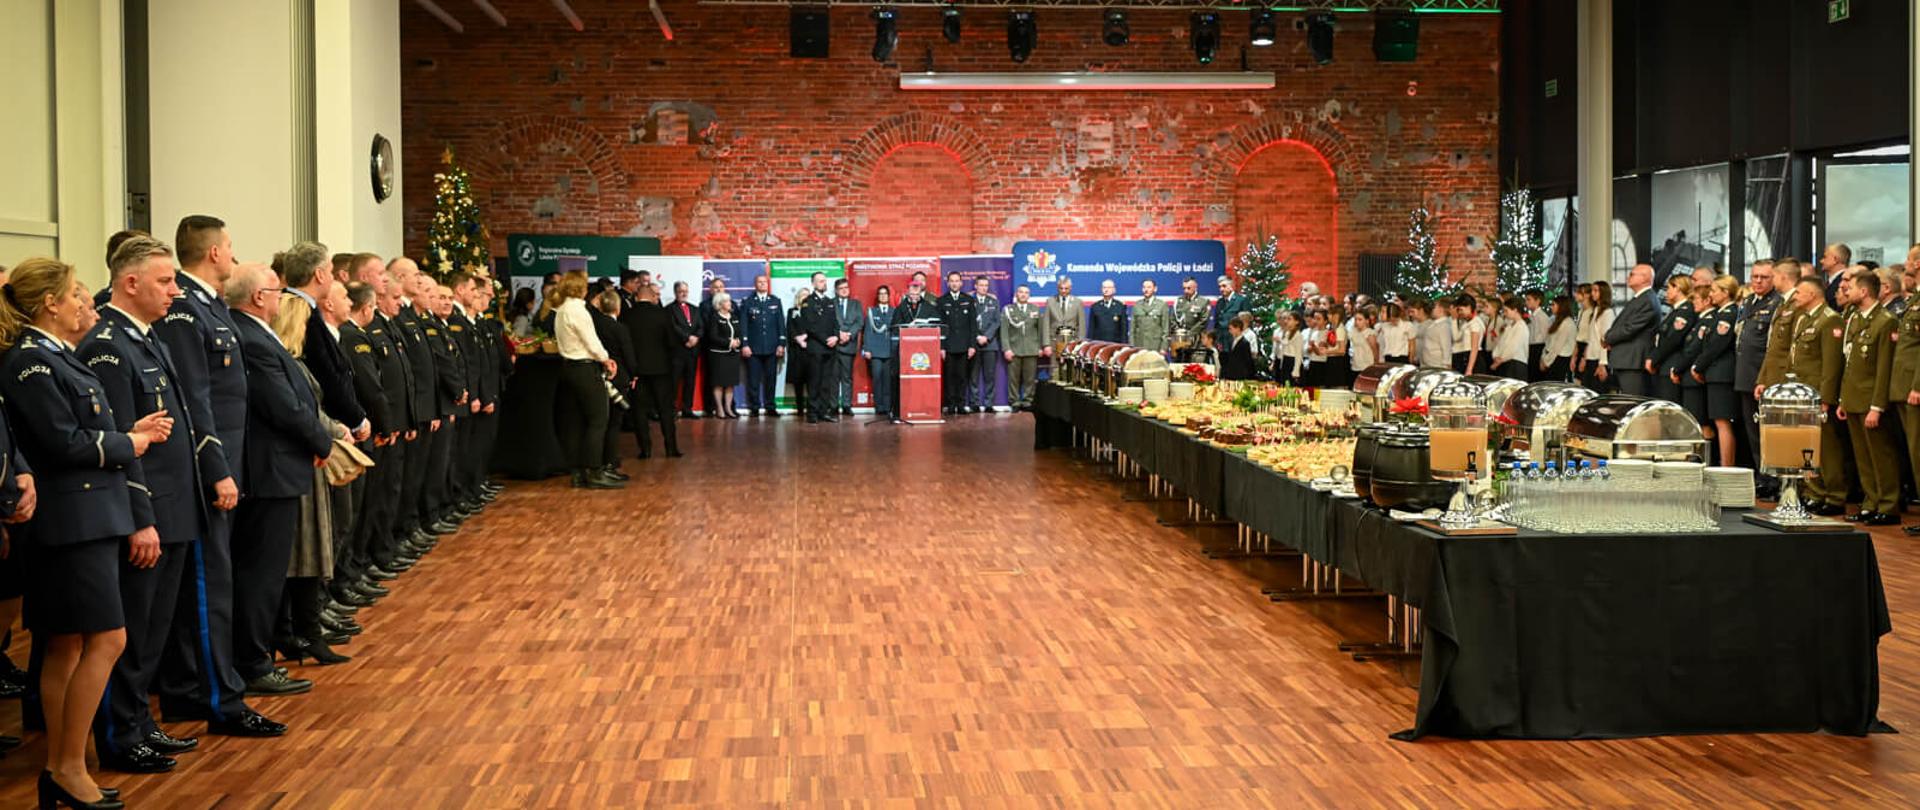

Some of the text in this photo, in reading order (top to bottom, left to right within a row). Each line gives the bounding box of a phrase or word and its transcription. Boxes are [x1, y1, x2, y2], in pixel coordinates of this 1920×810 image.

[1066, 262, 1214, 274] Komenda Wojewódzka Policji w Łodzi
[164, 312, 194, 323] POLICJA
[87, 354, 119, 367] POLICJA
[17, 365, 51, 381] POLICJA
